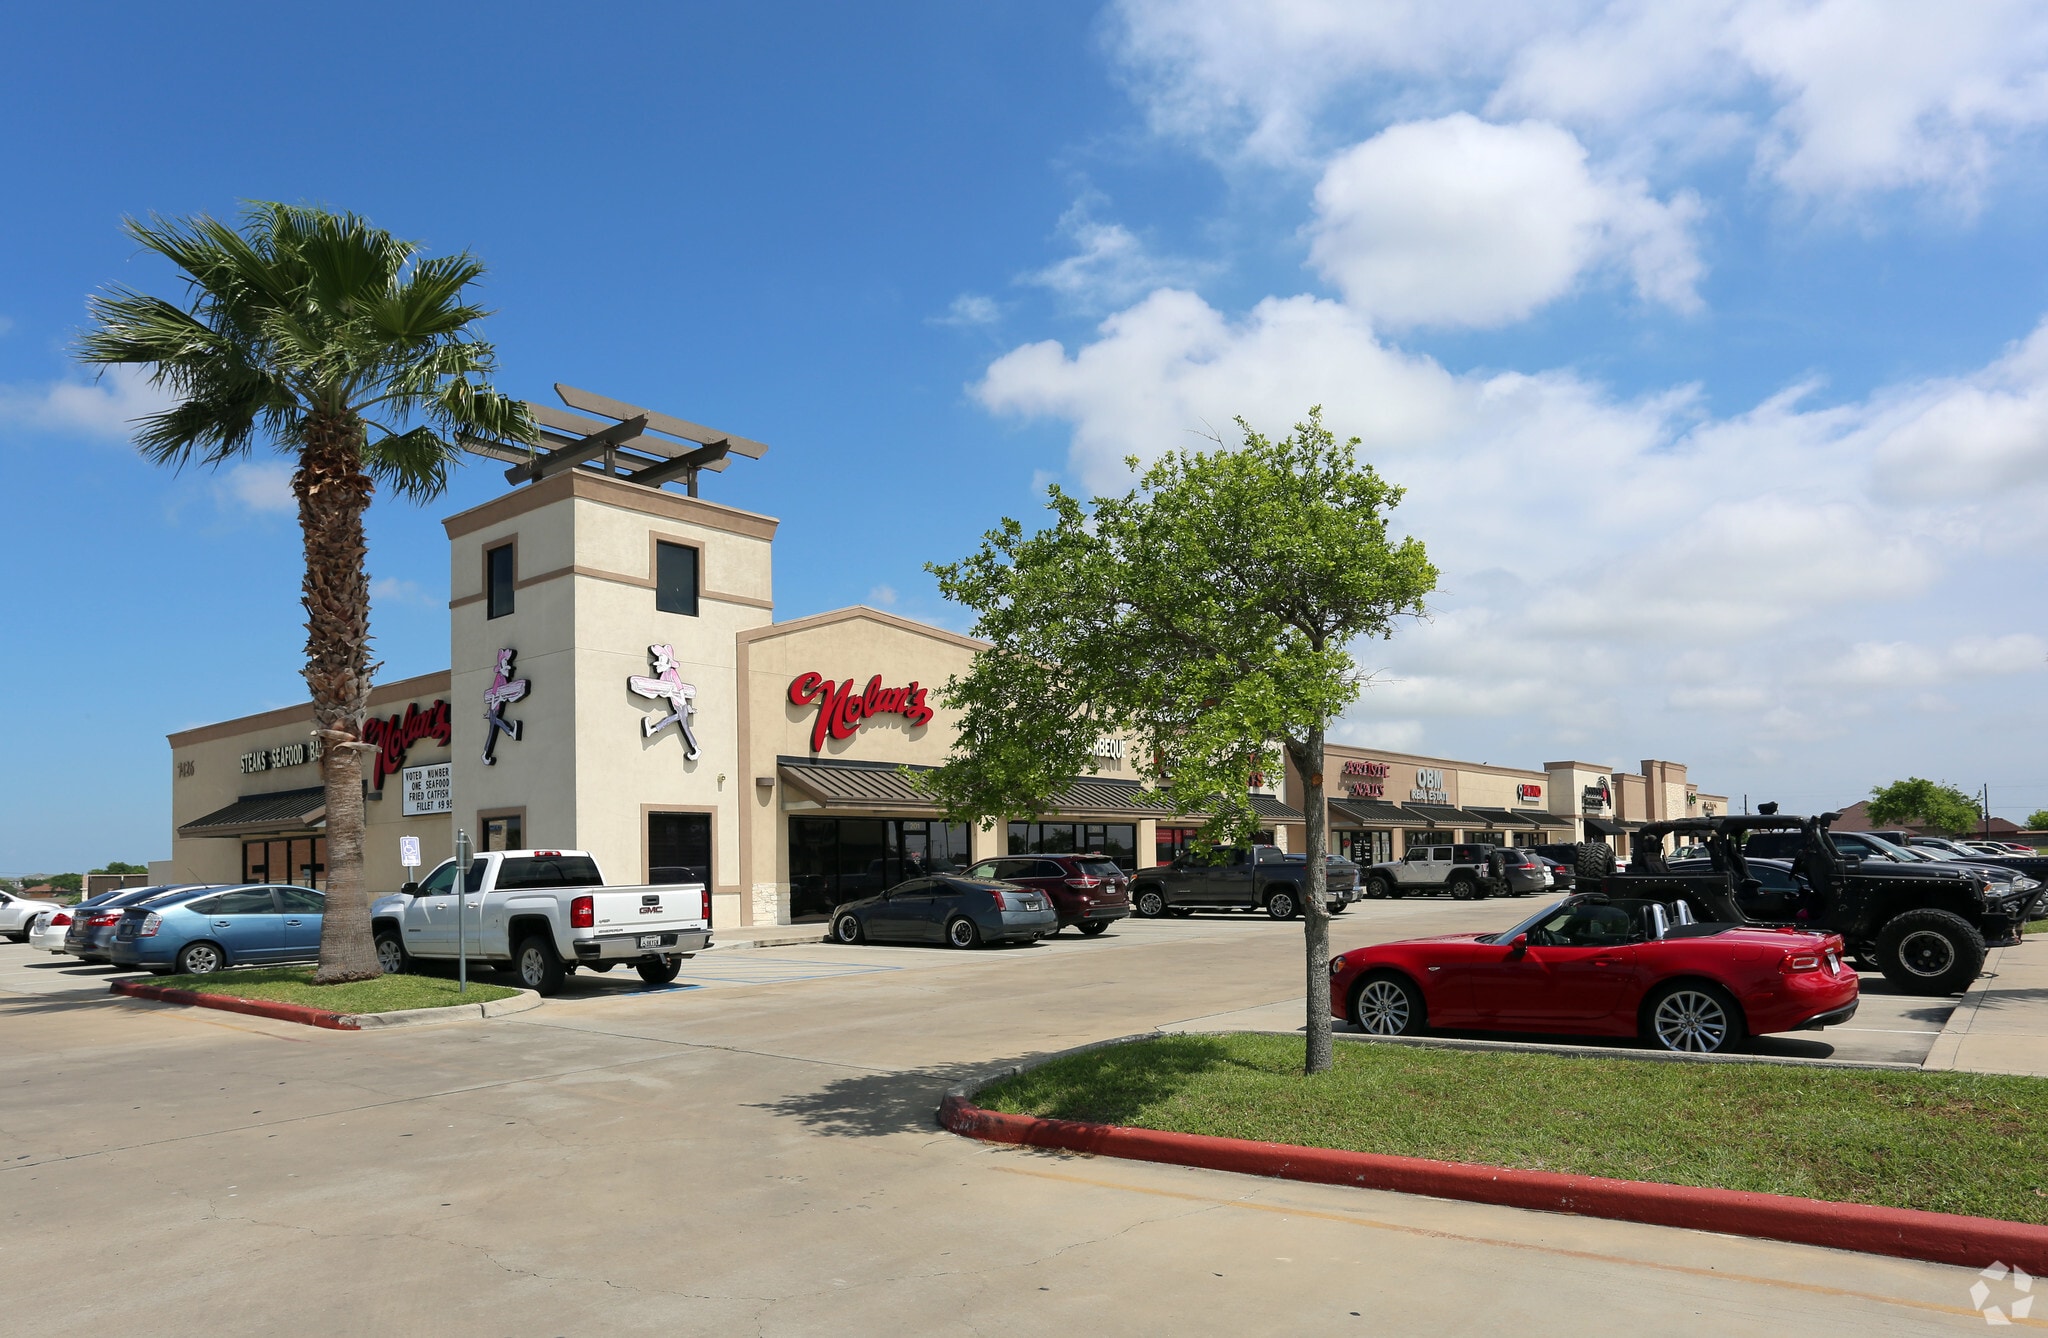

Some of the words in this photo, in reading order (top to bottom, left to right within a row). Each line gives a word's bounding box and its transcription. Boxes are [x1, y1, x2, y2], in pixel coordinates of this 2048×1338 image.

[788, 672, 934, 752] Nolan's
[240, 751, 266, 774] STEAKS
[271, 743, 304, 768] SEAFOOD
[309, 740, 322, 762] BA
[405, 771, 422, 781] VOTED
[427, 767, 449, 779] NUMBER
[411, 781, 422, 790] ONE
[425, 778, 450, 789] SEAFOOD
[1353, 782, 1384, 797] NAILS
[409, 792, 424, 801] FRIED
[427, 789, 449, 800] CATFISH
[1411, 789, 1427, 800] REAL
[1428, 790, 1450, 802] ESTATE
[416, 802, 434, 811] FILLET
[639, 906, 663, 915] GMC
